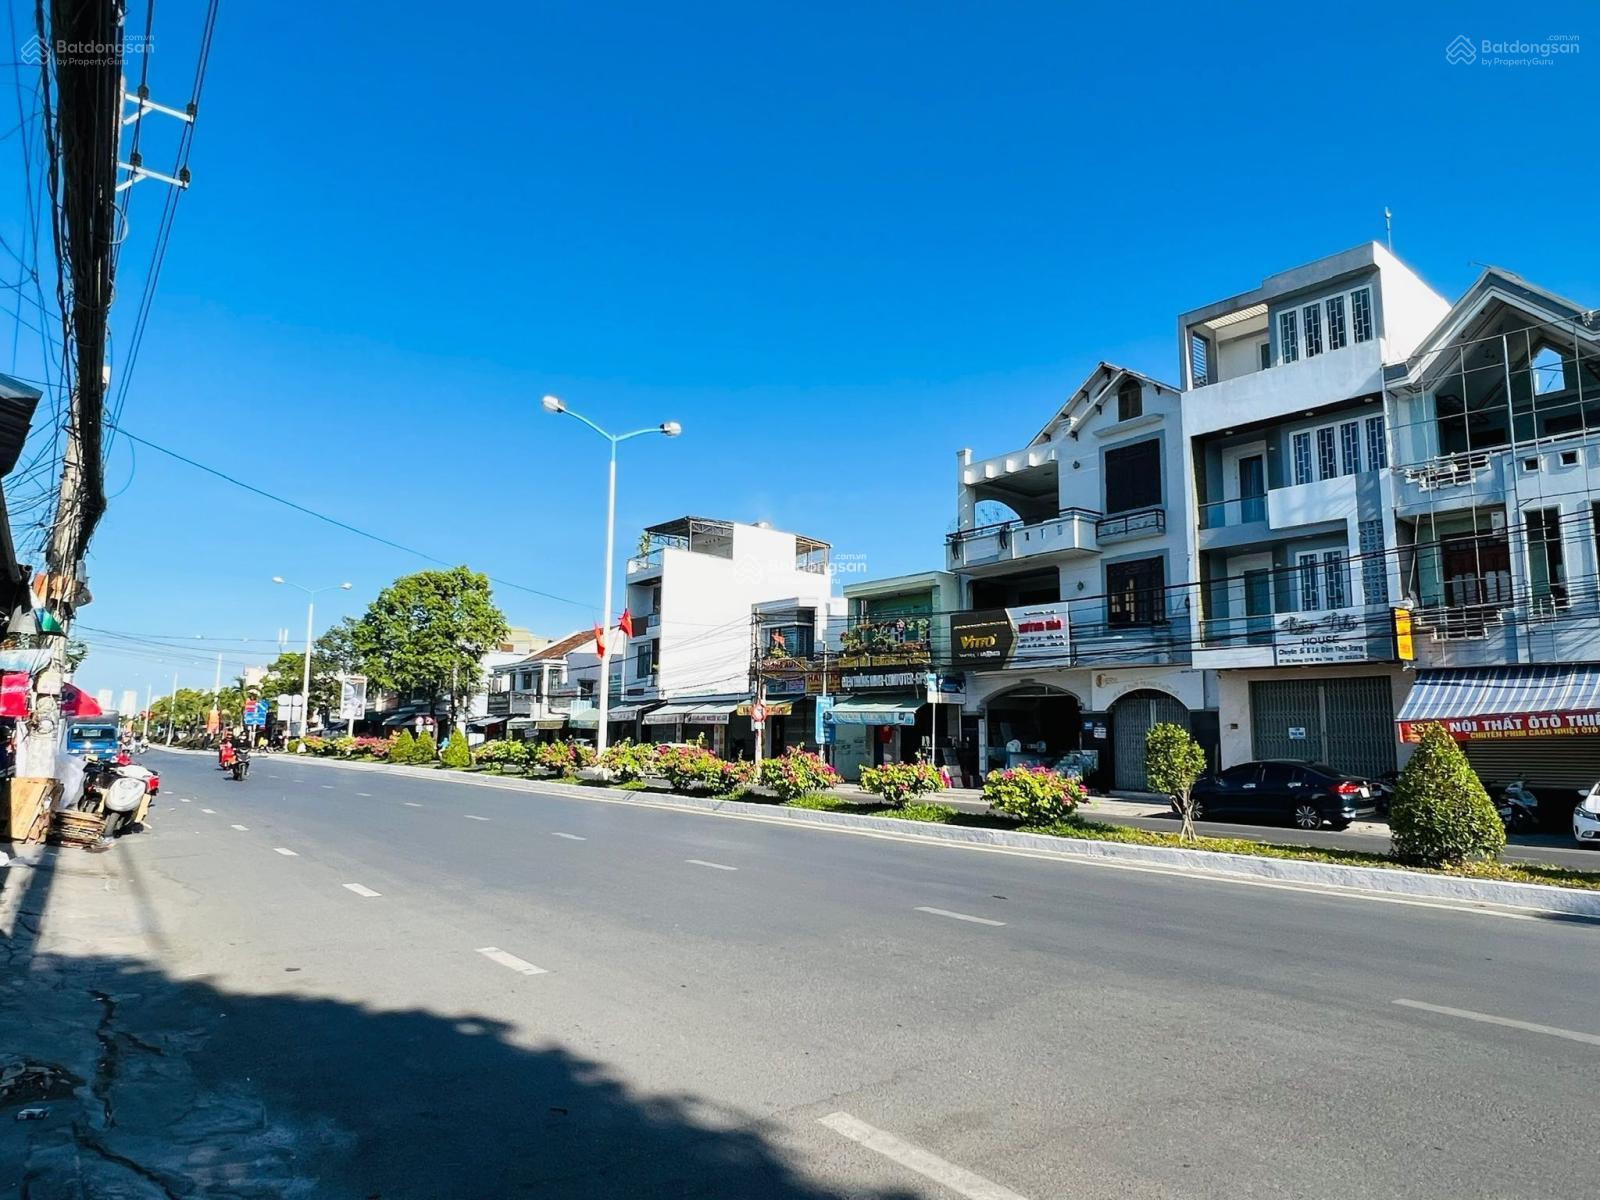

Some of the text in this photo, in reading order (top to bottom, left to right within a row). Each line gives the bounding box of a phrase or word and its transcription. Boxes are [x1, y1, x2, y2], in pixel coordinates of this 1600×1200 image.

[1302, 635, 1340, 645] HOUSE
[1449, 719, 1477, 734] NỘI
[1481, 716, 1522, 731] THẤT
[1528, 714, 1561, 728] ÔTÔ
